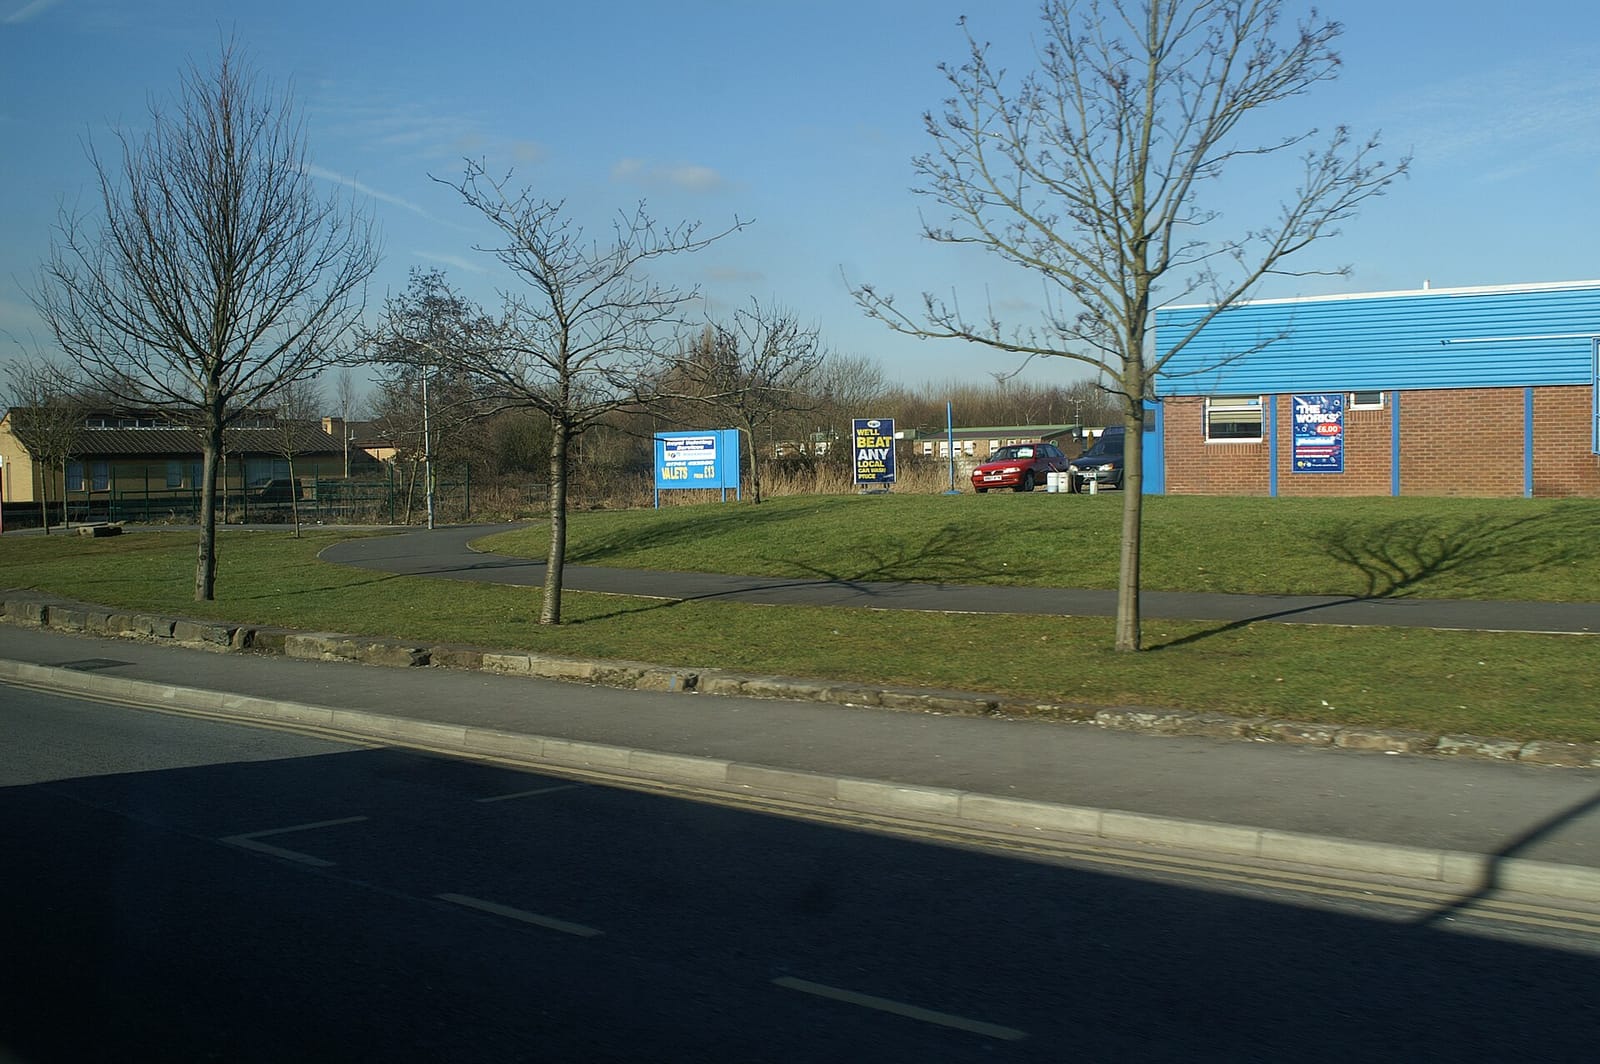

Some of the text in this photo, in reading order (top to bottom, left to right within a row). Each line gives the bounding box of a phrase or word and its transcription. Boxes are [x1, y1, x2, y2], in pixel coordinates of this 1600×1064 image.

[1317, 425, 1338, 433] £6.00
[857, 436, 892, 448] BEAT
[858, 448, 889, 460] ANY
[858, 460, 885, 468] LOCAL
[661, 466, 688, 480] VALETS
